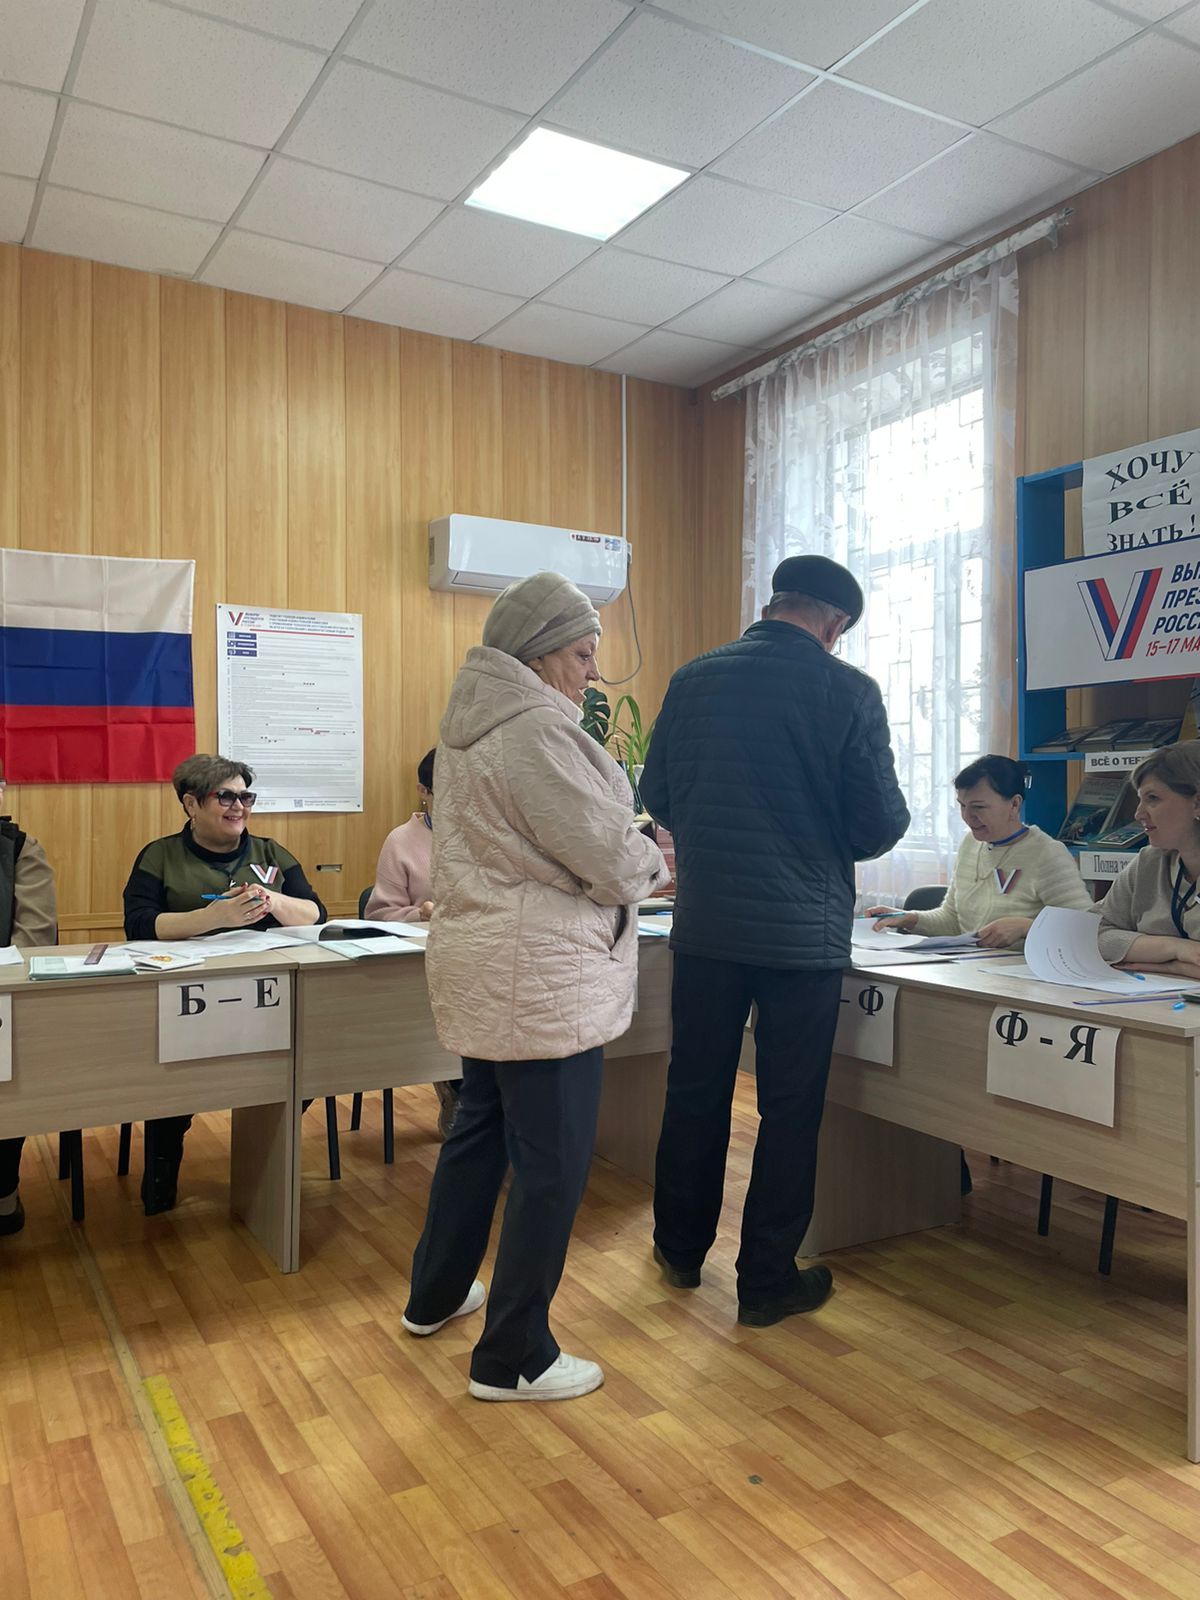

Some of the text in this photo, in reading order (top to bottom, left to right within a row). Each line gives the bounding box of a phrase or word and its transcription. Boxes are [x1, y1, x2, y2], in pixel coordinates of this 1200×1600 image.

[1105, 449, 1195, 492] ХОЧУ
[1107, 479, 1192, 525] ВСЁ
[1171, 561, 1200, 583] ВЫ
[1152, 611, 1200, 635] РОСС
[1090, 756, 1110, 767] ВСЁ
[1112, 757, 1120, 766] О
[176, 983, 207, 1017] Б
[252, 977, 281, 1009] Е
[858, 984, 884, 1017] Ф
[995, 1010, 1029, 1048] Ф
[1063, 1024, 1102, 1066] Я
